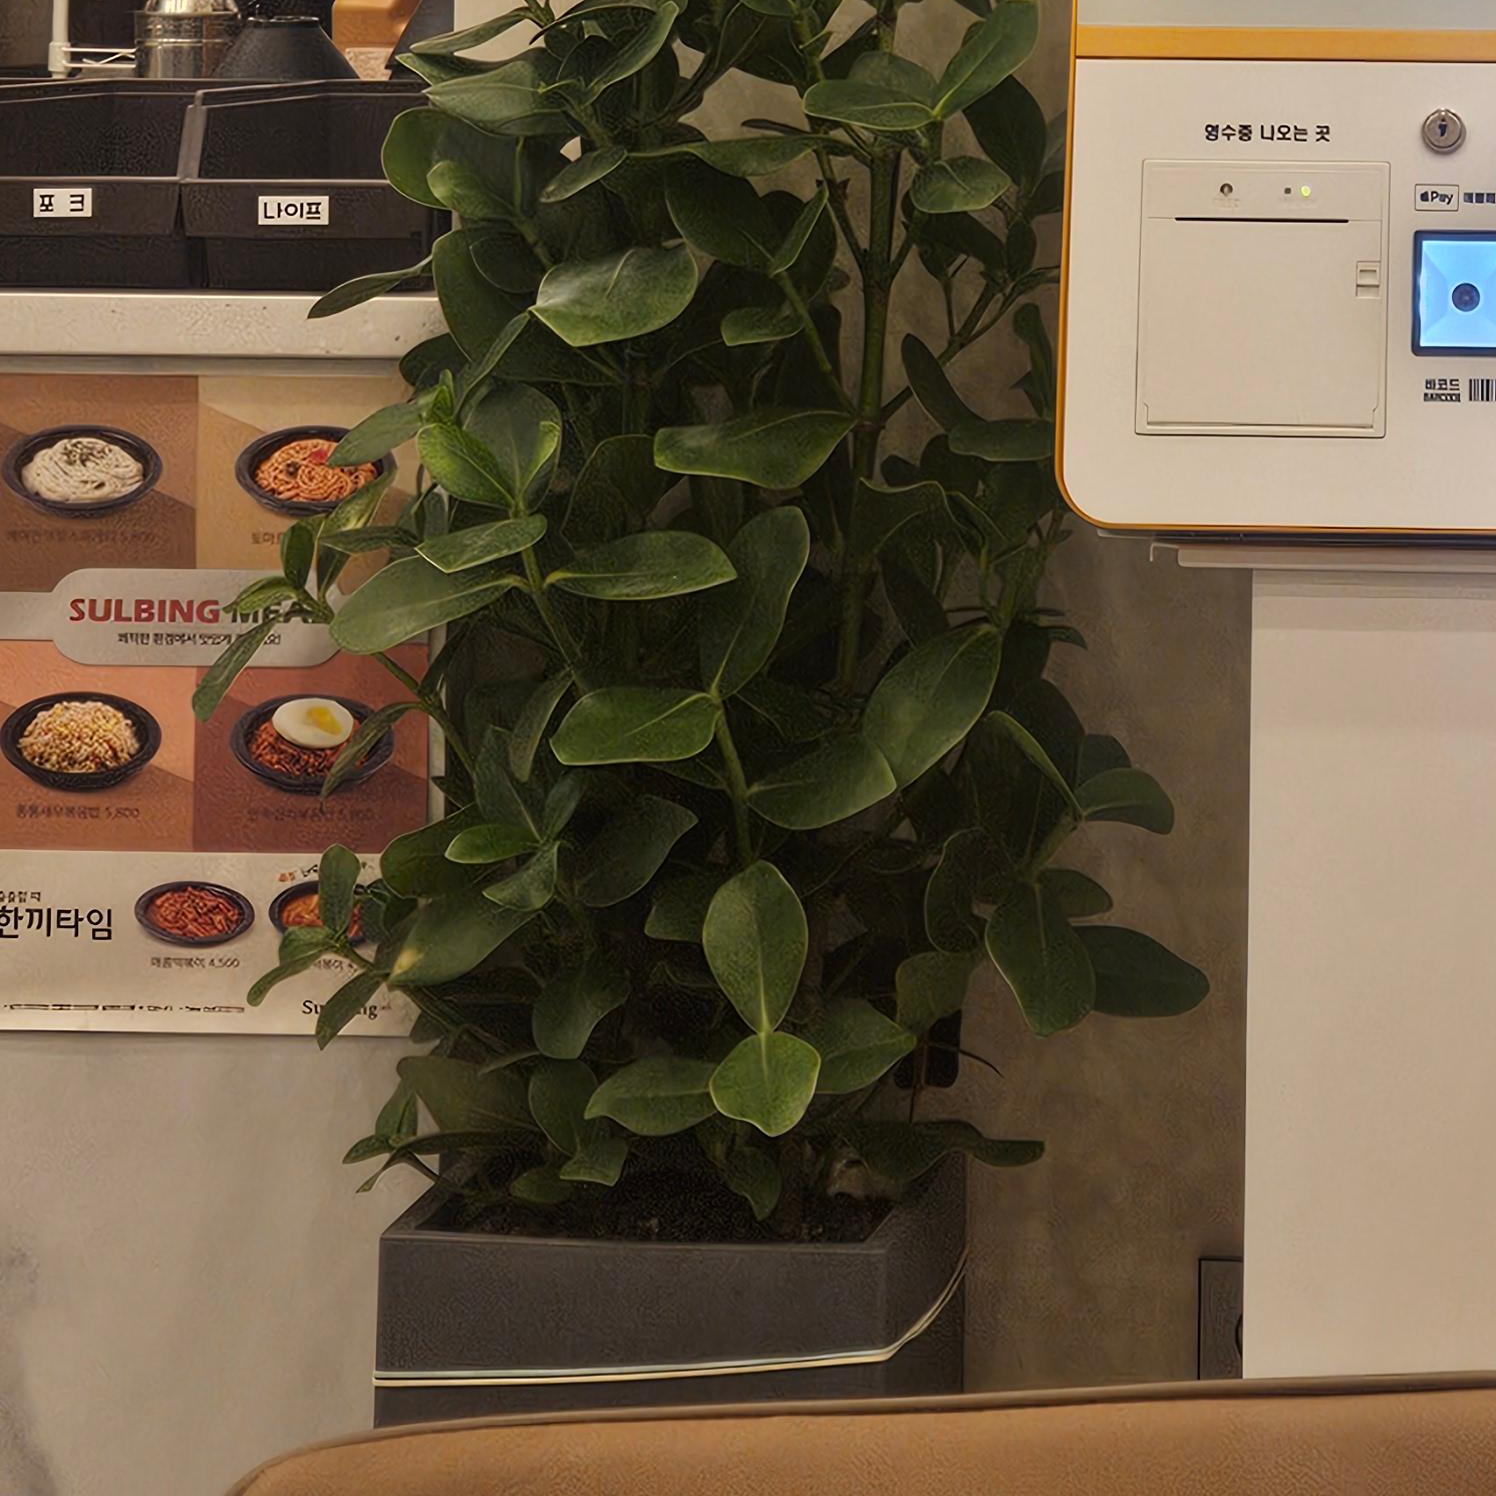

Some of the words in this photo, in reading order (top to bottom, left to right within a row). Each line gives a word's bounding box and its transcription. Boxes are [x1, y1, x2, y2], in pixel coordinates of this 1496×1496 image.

[1204, 123, 1253, 142] 영수증
[1260, 124, 1308, 142] 나오는
[1314, 124, 1332, 143] 곳
[262, 200, 322, 220] 나이프
[68, 598, 221, 624] SULBING
[230, 598, 322, 624] MEA
[0, 905, 113, 941] 한끼타임
[208, 957, 241, 969] 4,500
